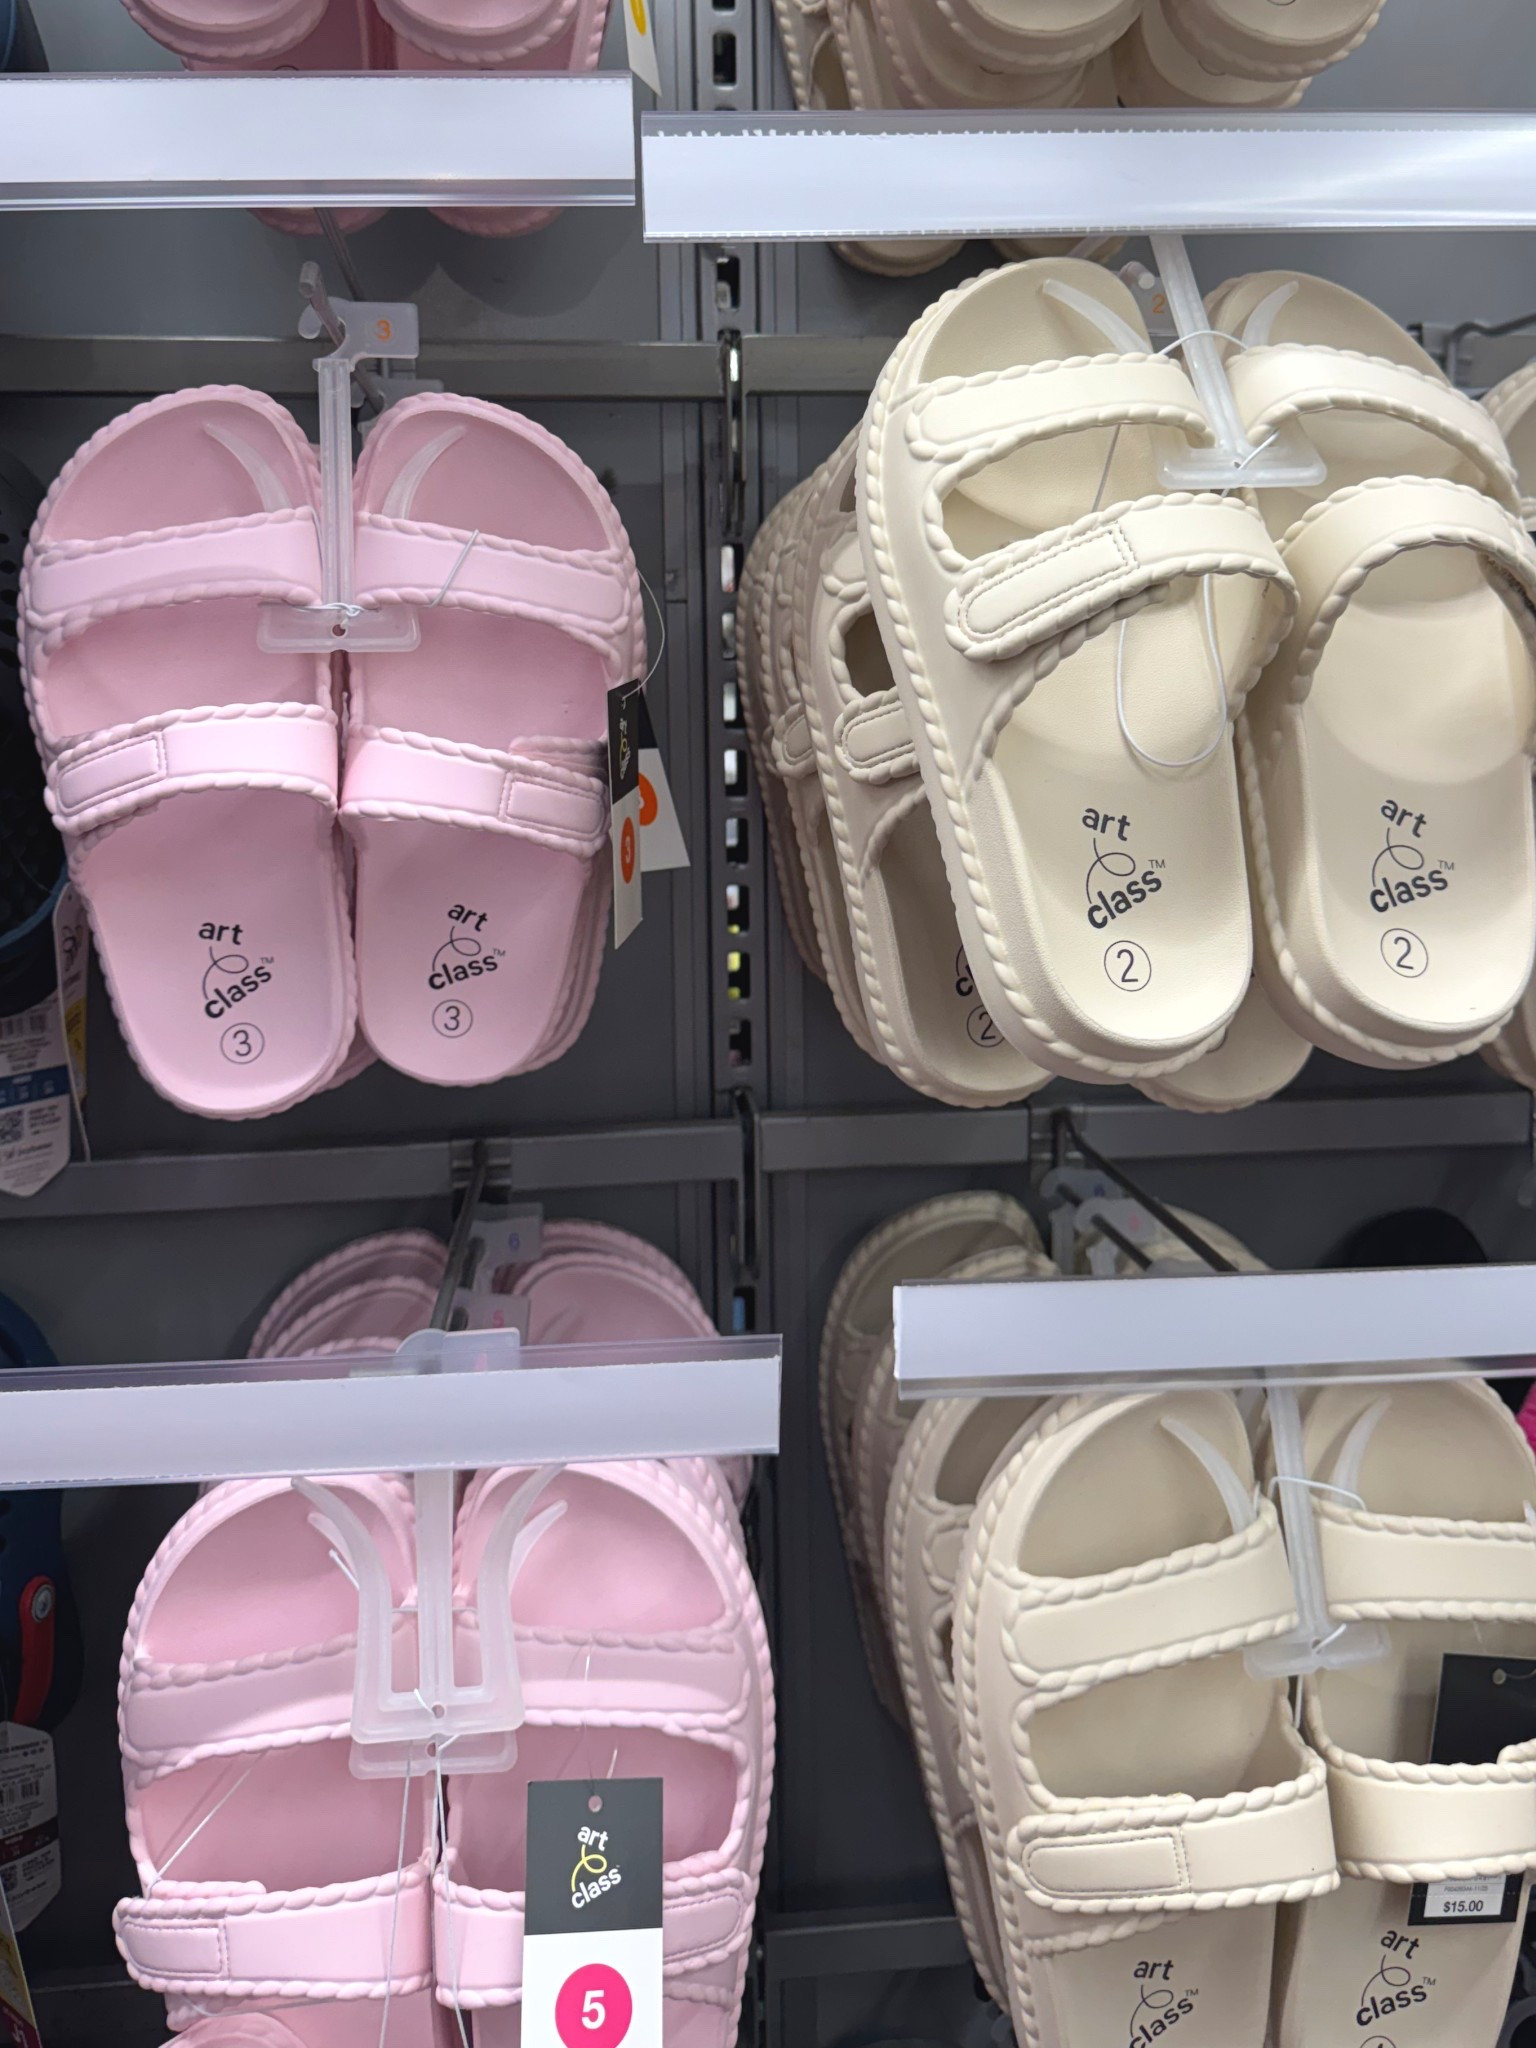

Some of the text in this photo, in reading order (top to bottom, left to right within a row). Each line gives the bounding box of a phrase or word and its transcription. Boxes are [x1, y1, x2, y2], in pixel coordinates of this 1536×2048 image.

[1151, 293, 1165, 314] 2
[376, 319, 391, 341] 3
[1082, 808, 1131, 842] art
[1380, 799, 1427, 838] art
[624, 836, 632, 864] 3
[447, 904, 488, 932] art
[199, 922, 243, 945] art
[1116, 948, 1139, 983] 2
[1393, 936, 1414, 970] 2
[444, 1005, 460, 1031] 3
[978, 1011, 996, 1040] 2
[233, 1029, 252, 1057] 3
[577, 1826, 608, 1850] art
[571, 1867, 622, 1908] class
[1443, 1900, 1484, 1913] $15.00
[1380, 1930, 1420, 1960] art
[1133, 1959, 1174, 1981] art
[581, 1989, 606, 2030] 5
